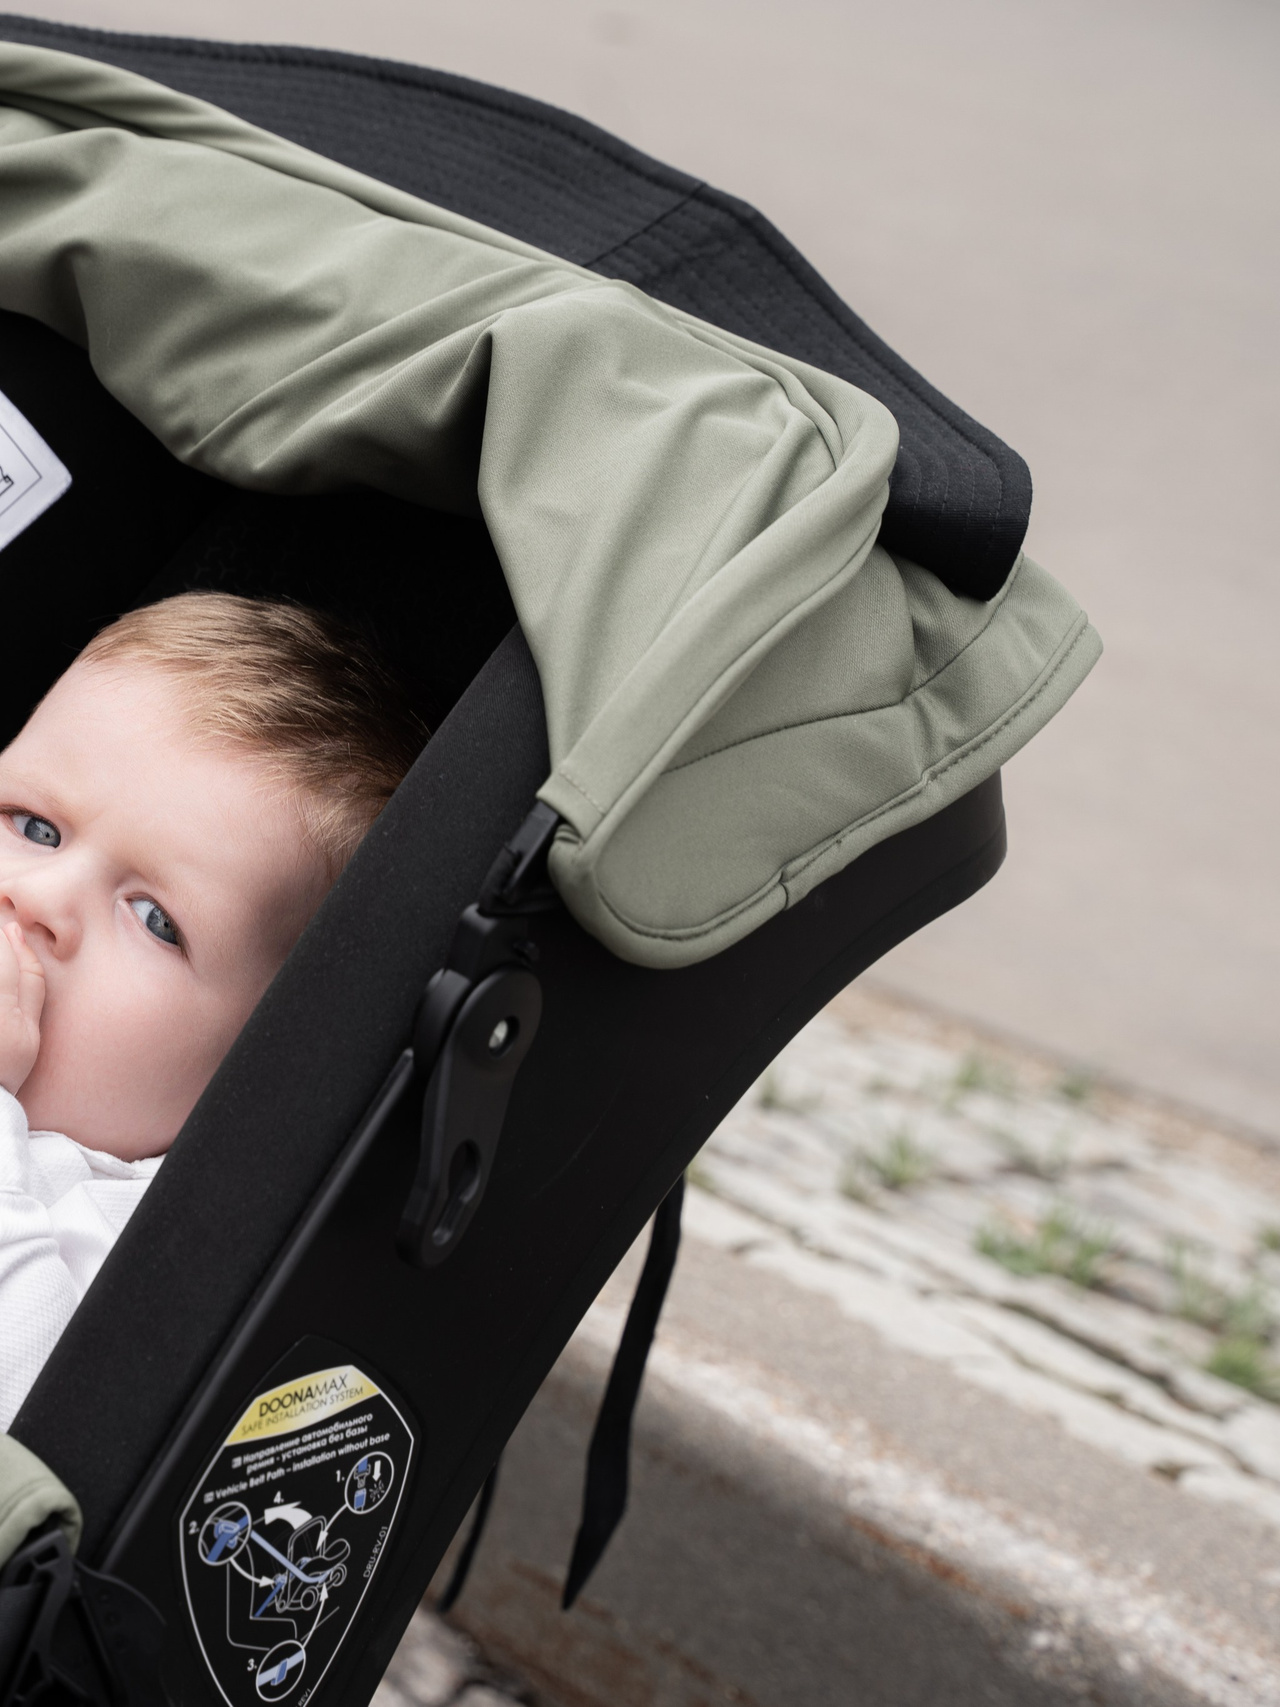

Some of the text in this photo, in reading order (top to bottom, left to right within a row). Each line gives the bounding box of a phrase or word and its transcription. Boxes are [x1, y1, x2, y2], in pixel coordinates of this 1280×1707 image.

[241, 1386, 364, 1436] SAFE INSTALLATION SYSTEM
[259, 1373, 348, 1418] DOONAMAX
[242, 1437, 300, 1463] Направление
[301, 1412, 373, 1443] автомобильного
[281, 1439, 327, 1463] установка
[328, 1433, 344, 1444] без
[345, 1425, 368, 1438] базы
[214, 1479, 248, 1500] Vehicle
[249, 1473, 265, 1488] Belt
[266, 1465, 285, 1482] Path
[292, 1448, 337, 1471] installation
[338, 1437, 368, 1456] without
[370, 1432, 390, 1445] base
